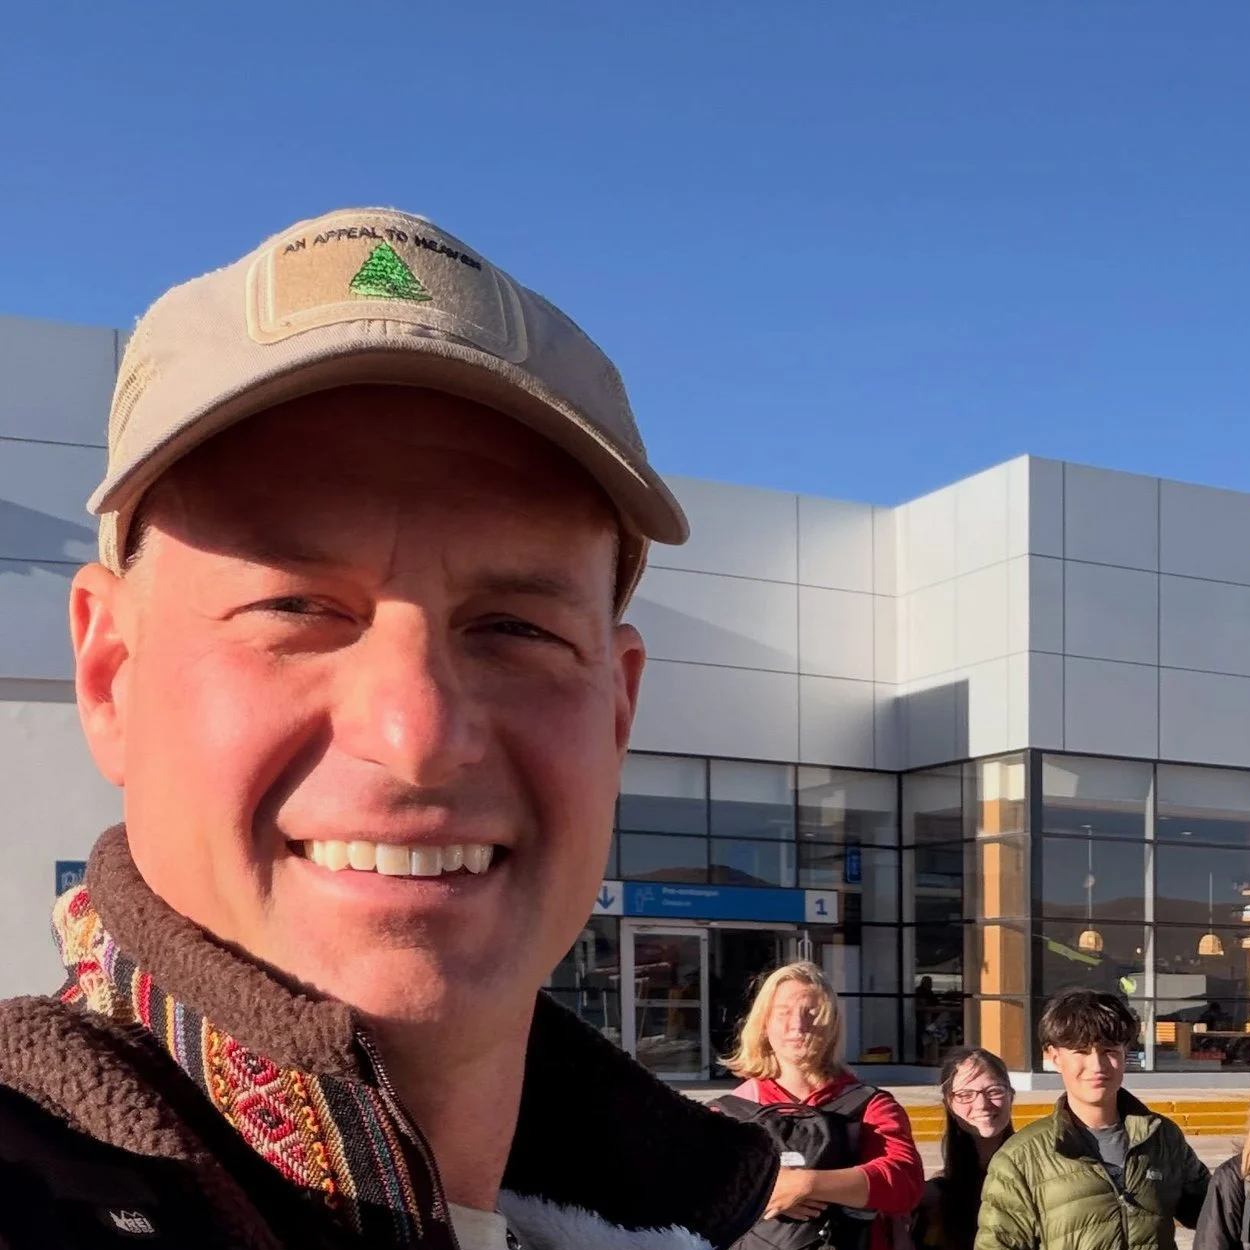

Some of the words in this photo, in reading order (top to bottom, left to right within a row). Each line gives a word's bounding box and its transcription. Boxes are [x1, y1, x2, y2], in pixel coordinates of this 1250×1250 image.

[283, 237, 306, 256] AN
[314, 227, 384, 245] APPEAL
[386, 227, 409, 243] TO
[815, 898, 828, 915] 1
